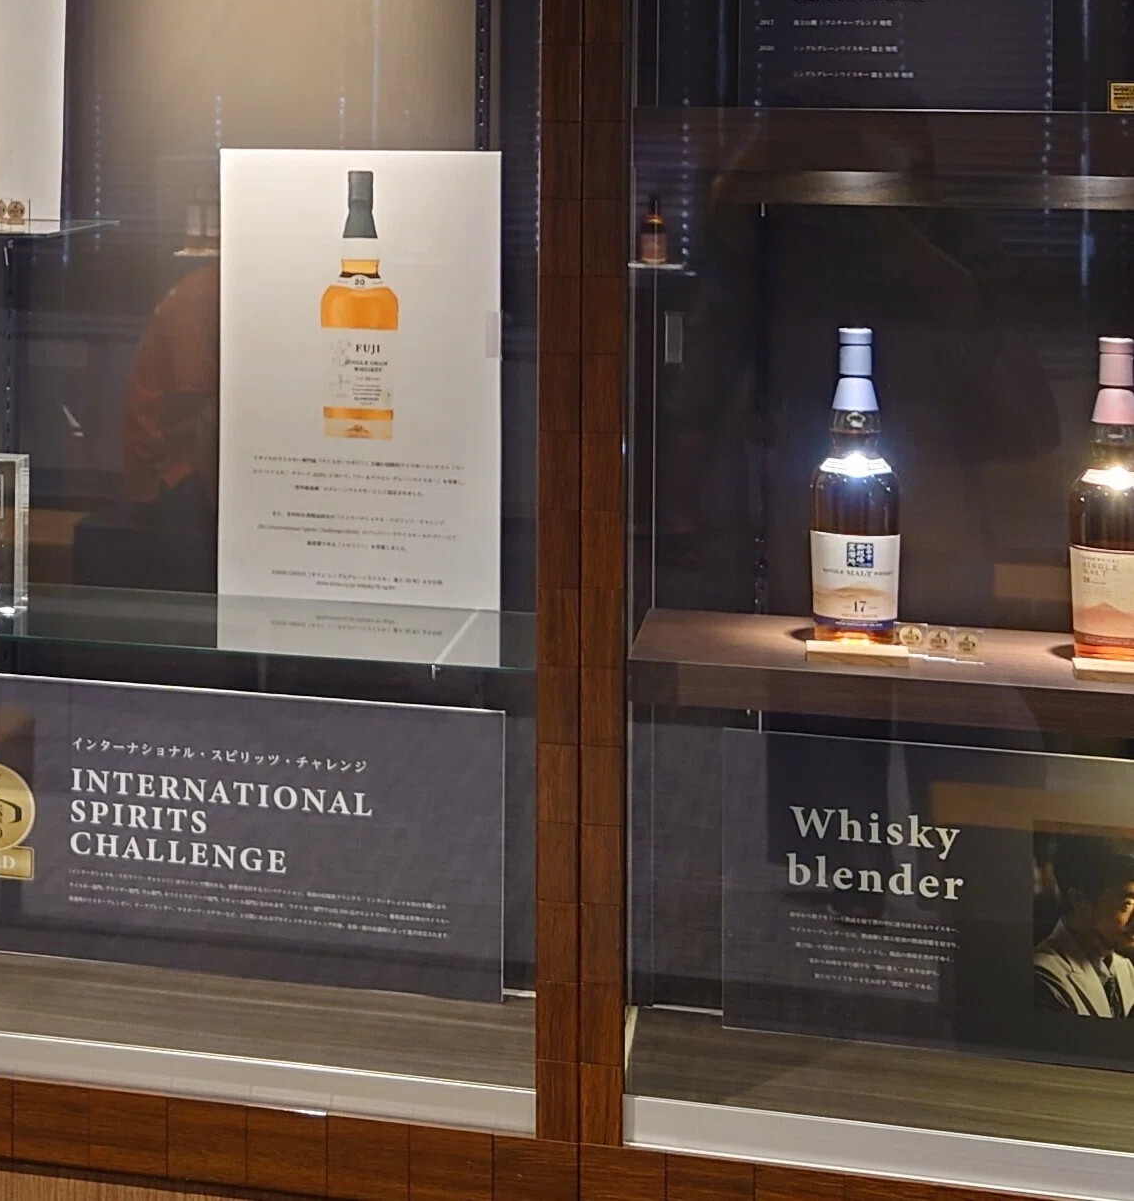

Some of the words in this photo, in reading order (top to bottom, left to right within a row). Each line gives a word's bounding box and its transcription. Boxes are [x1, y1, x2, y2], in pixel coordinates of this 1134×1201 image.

[356, 343, 380, 356] FUJI
[846, 570, 872, 578] MALT
[854, 600, 867, 613] 17
[71, 736, 368, 773] インターナショナル・スピリッツ・チャレンジ
[70, 767, 373, 817] INTERNATIONAL
[70, 799, 207, 834] SPIRITS
[789, 805, 961, 861] Whisky
[69, 831, 287, 874] CHALLENGE
[786, 852, 964, 901] blender
